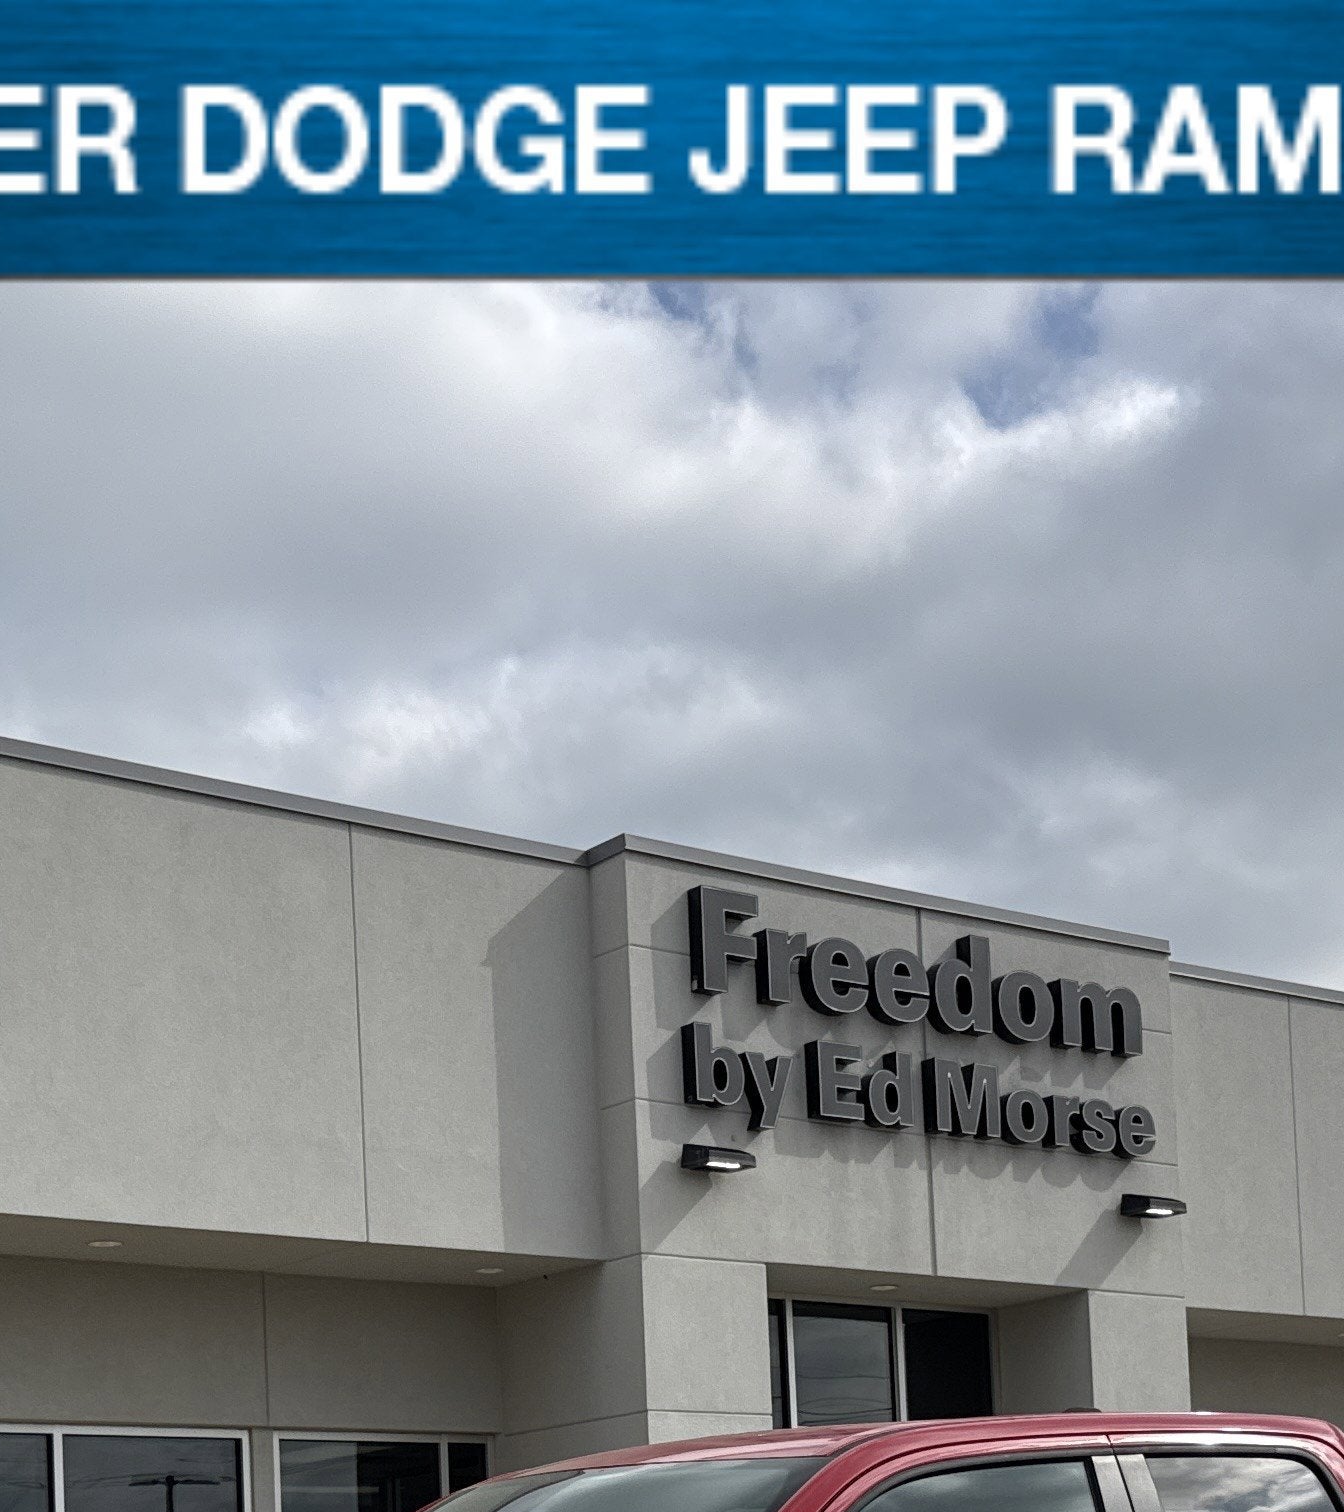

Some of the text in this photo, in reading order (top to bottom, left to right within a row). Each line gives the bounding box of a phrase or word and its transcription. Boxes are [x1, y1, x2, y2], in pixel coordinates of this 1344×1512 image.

[688, 885, 1143, 1056] Freedom
[681, 1021, 1156, 1160] by Ed Morse
